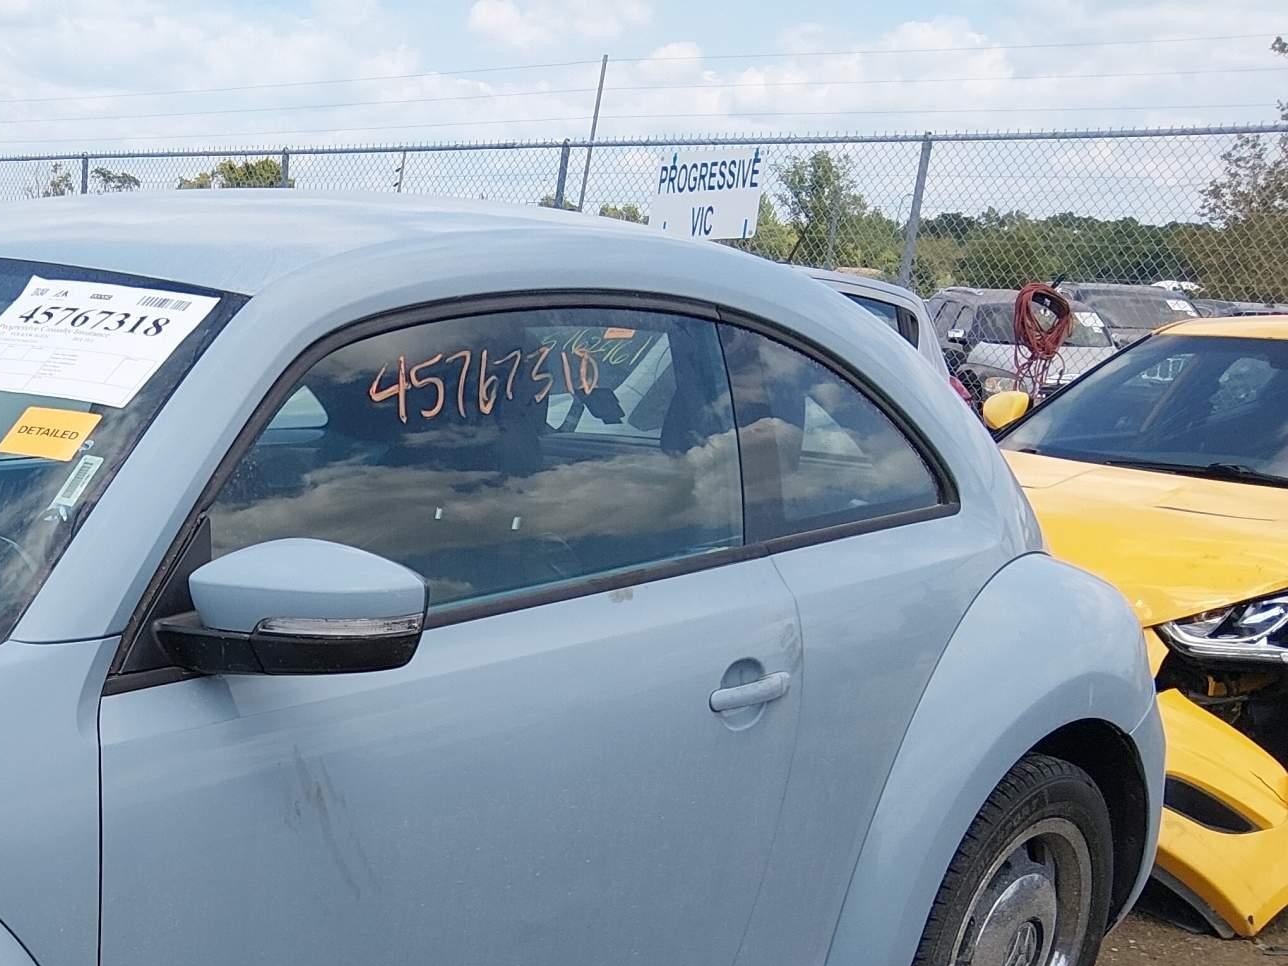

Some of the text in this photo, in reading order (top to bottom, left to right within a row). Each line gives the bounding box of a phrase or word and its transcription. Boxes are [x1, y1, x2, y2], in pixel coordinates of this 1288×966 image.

[658, 157, 762, 194] PROGRESSIVE
[691, 205, 714, 237] VIC
[18, 304, 170, 337] 45767318
[369, 345, 599, 424] 45767318
[17, 425, 80, 440] DETAILED
